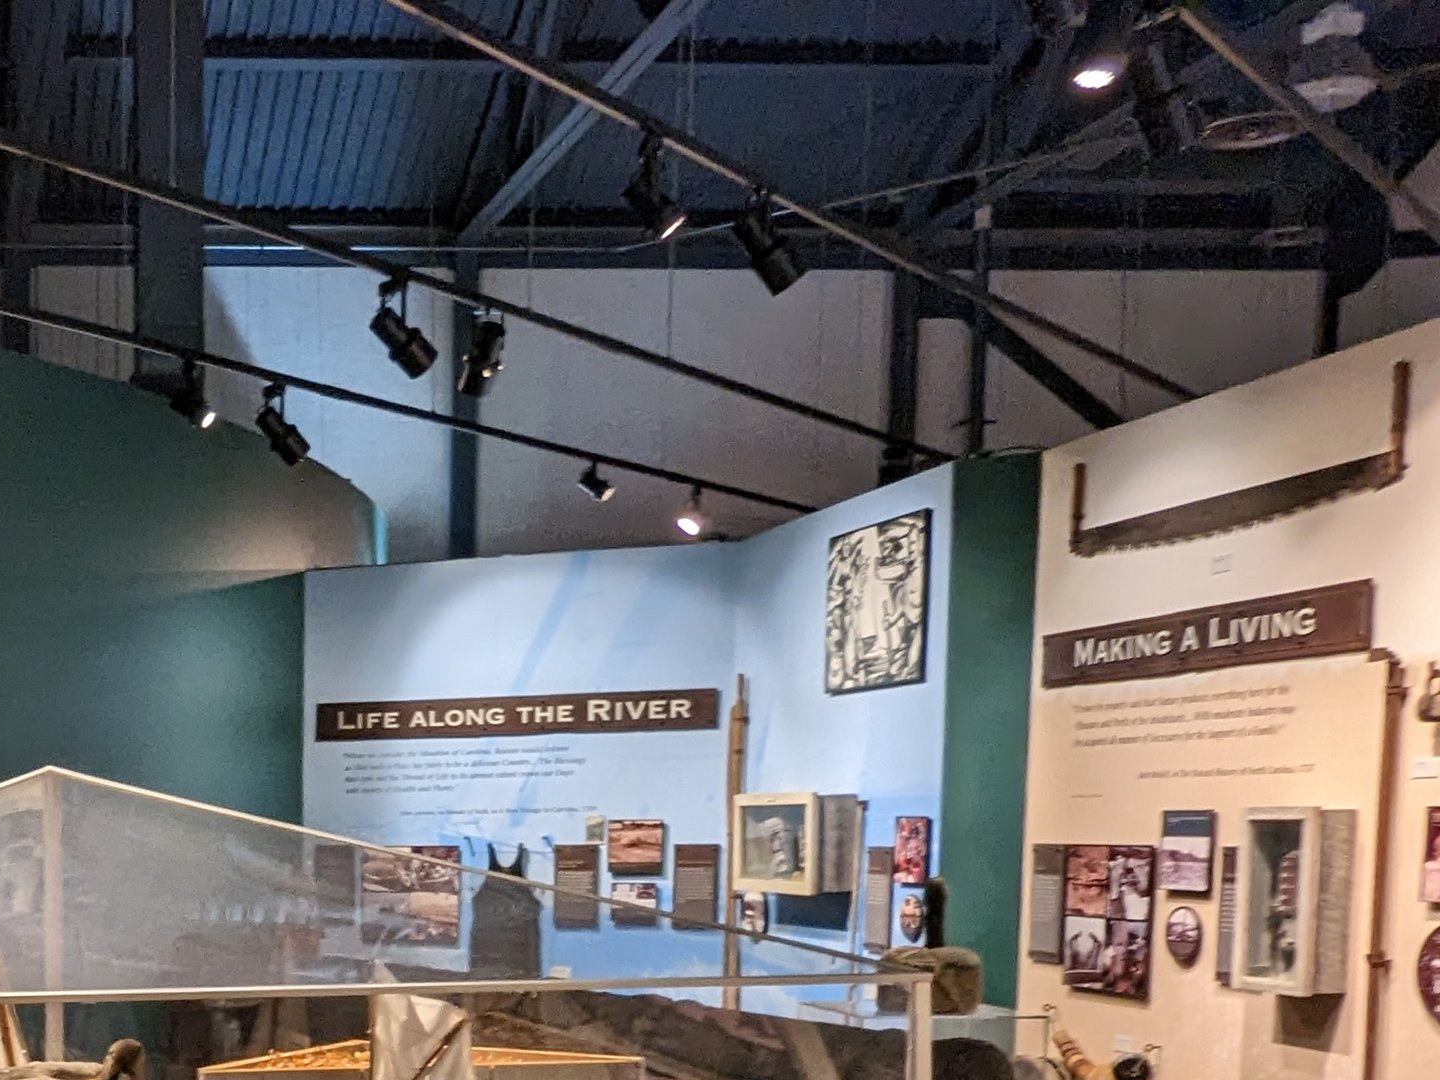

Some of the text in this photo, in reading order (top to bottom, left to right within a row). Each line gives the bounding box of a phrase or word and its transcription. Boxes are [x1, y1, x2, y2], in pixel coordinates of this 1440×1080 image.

[1073, 607, 1317, 667] MAKING A LIVING
[337, 699, 692, 730] LIFE ALONG THE RIVER
